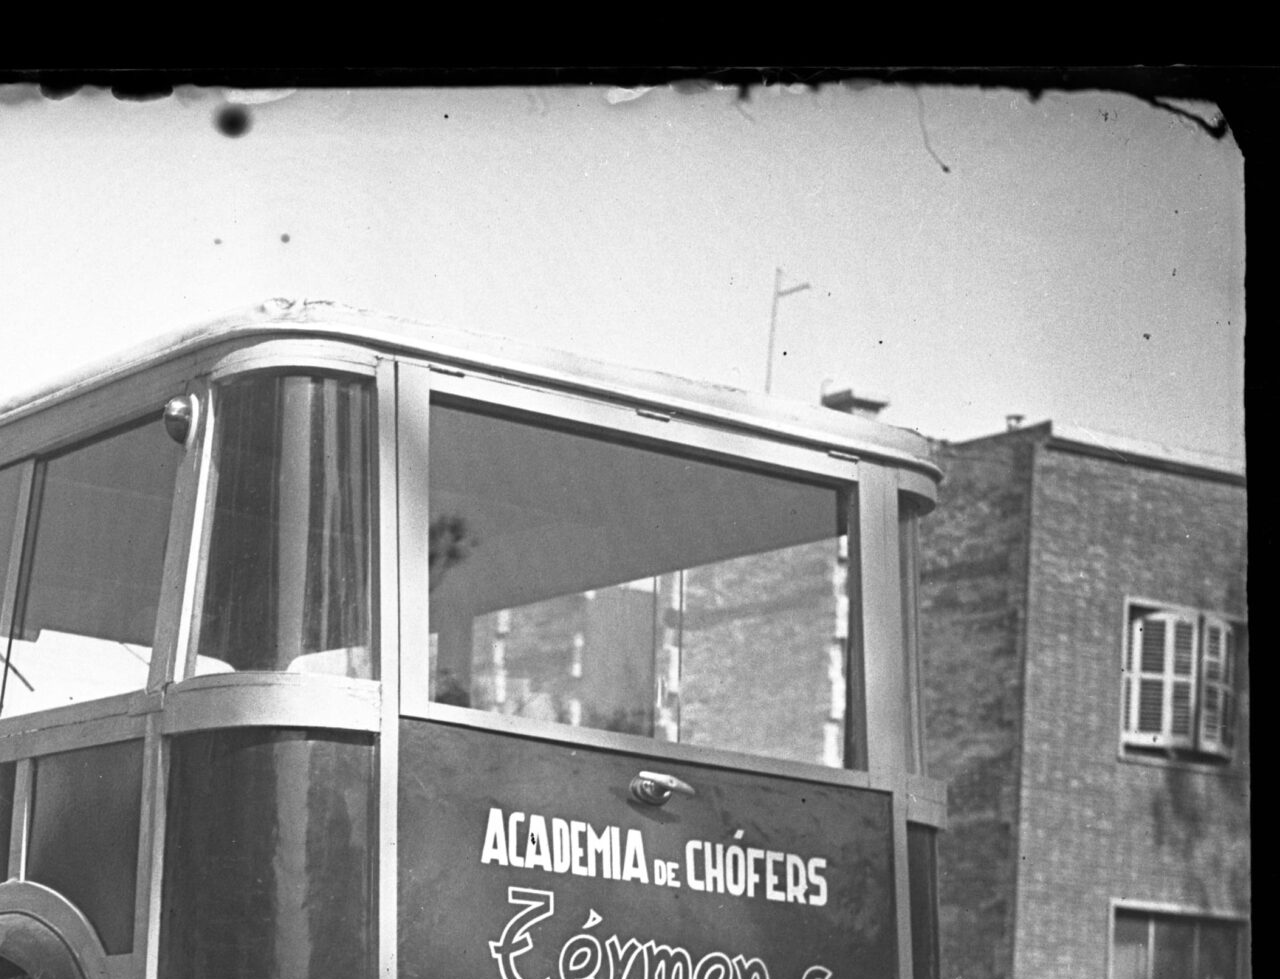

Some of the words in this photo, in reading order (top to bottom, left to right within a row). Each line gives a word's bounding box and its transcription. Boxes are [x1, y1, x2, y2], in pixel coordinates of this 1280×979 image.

[482, 808, 648, 883] ACADEMIA
[654, 858, 681, 887] DE
[685, 830, 828, 906] CHÓFERS
